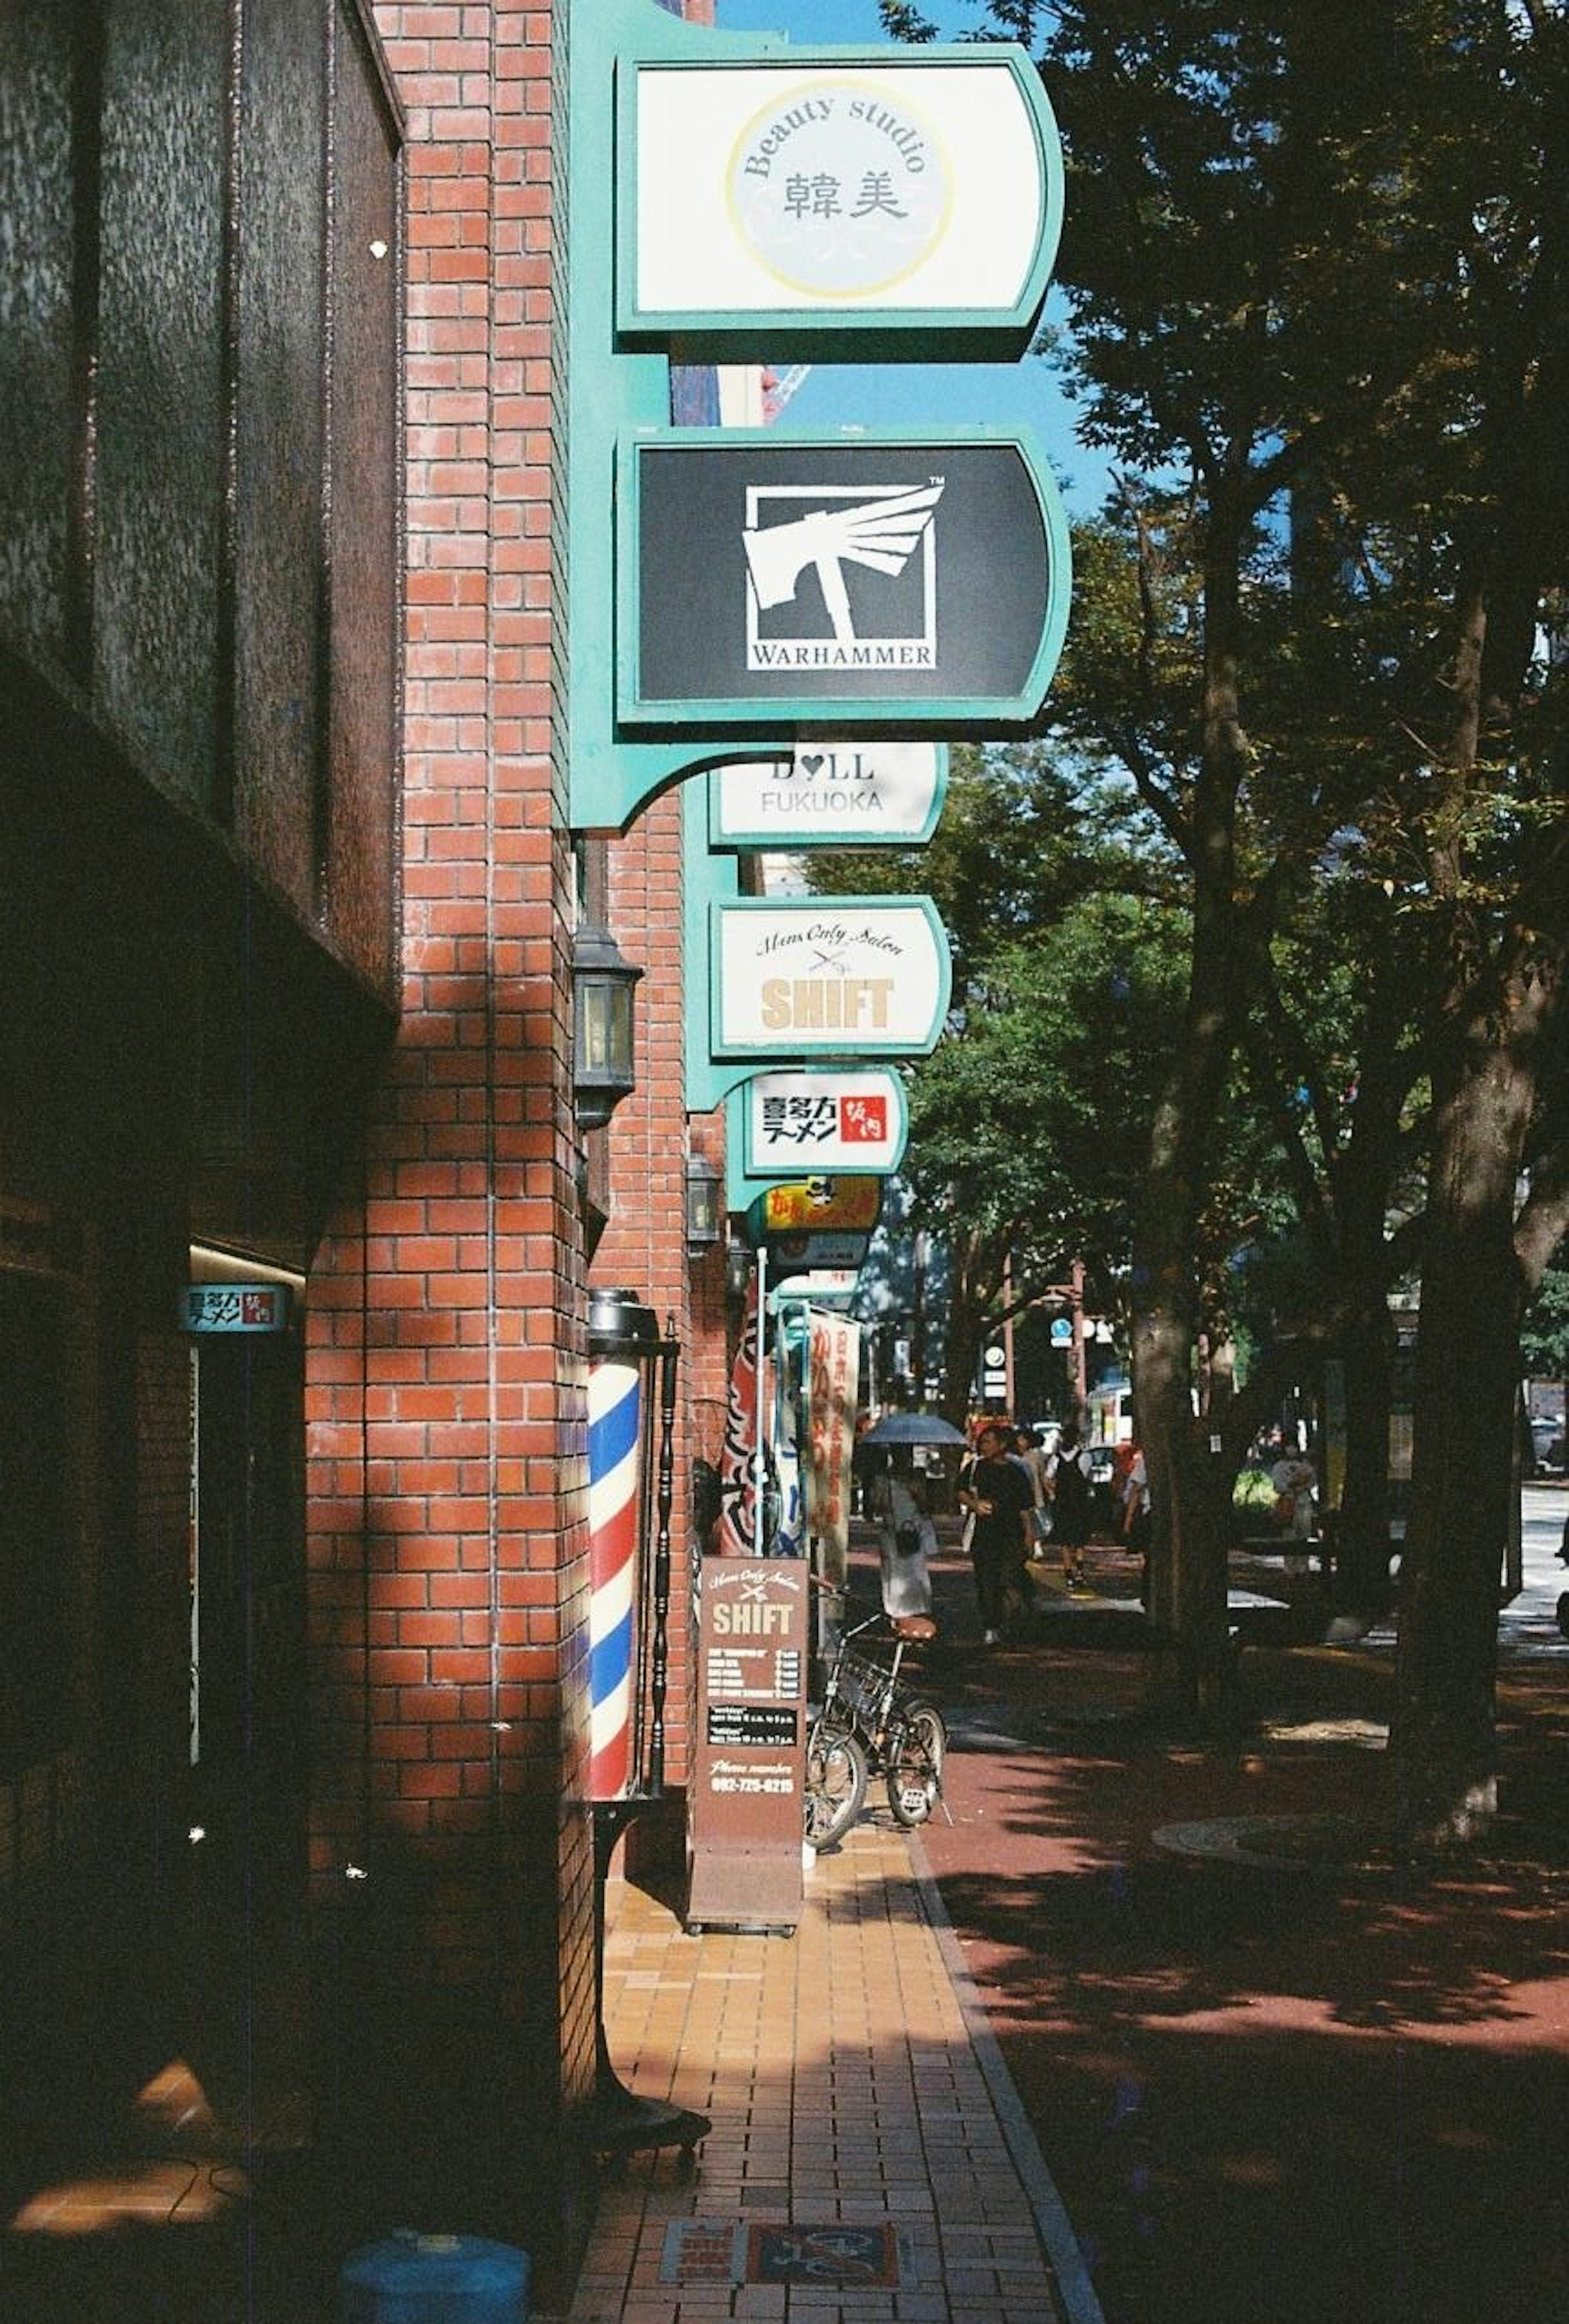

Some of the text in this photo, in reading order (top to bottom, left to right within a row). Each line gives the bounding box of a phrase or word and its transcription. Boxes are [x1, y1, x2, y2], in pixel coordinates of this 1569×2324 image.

[744, 98, 925, 179] Beauty studio
[784, 170, 909, 220] 韓美
[929, 476, 945, 487] TM
[753, 644, 931, 666] WARHAMMER
[762, 791, 883, 813] FUKUOKA
[807, 923, 847, 945] Only
[849, 927, 905, 955] Salon
[762, 979, 894, 1030] SHIFT
[763, 1097, 836, 1118] 喜多方
[763, 1121, 837, 1143] ラーメン
[713, 1604, 794, 1635] SHIFT
